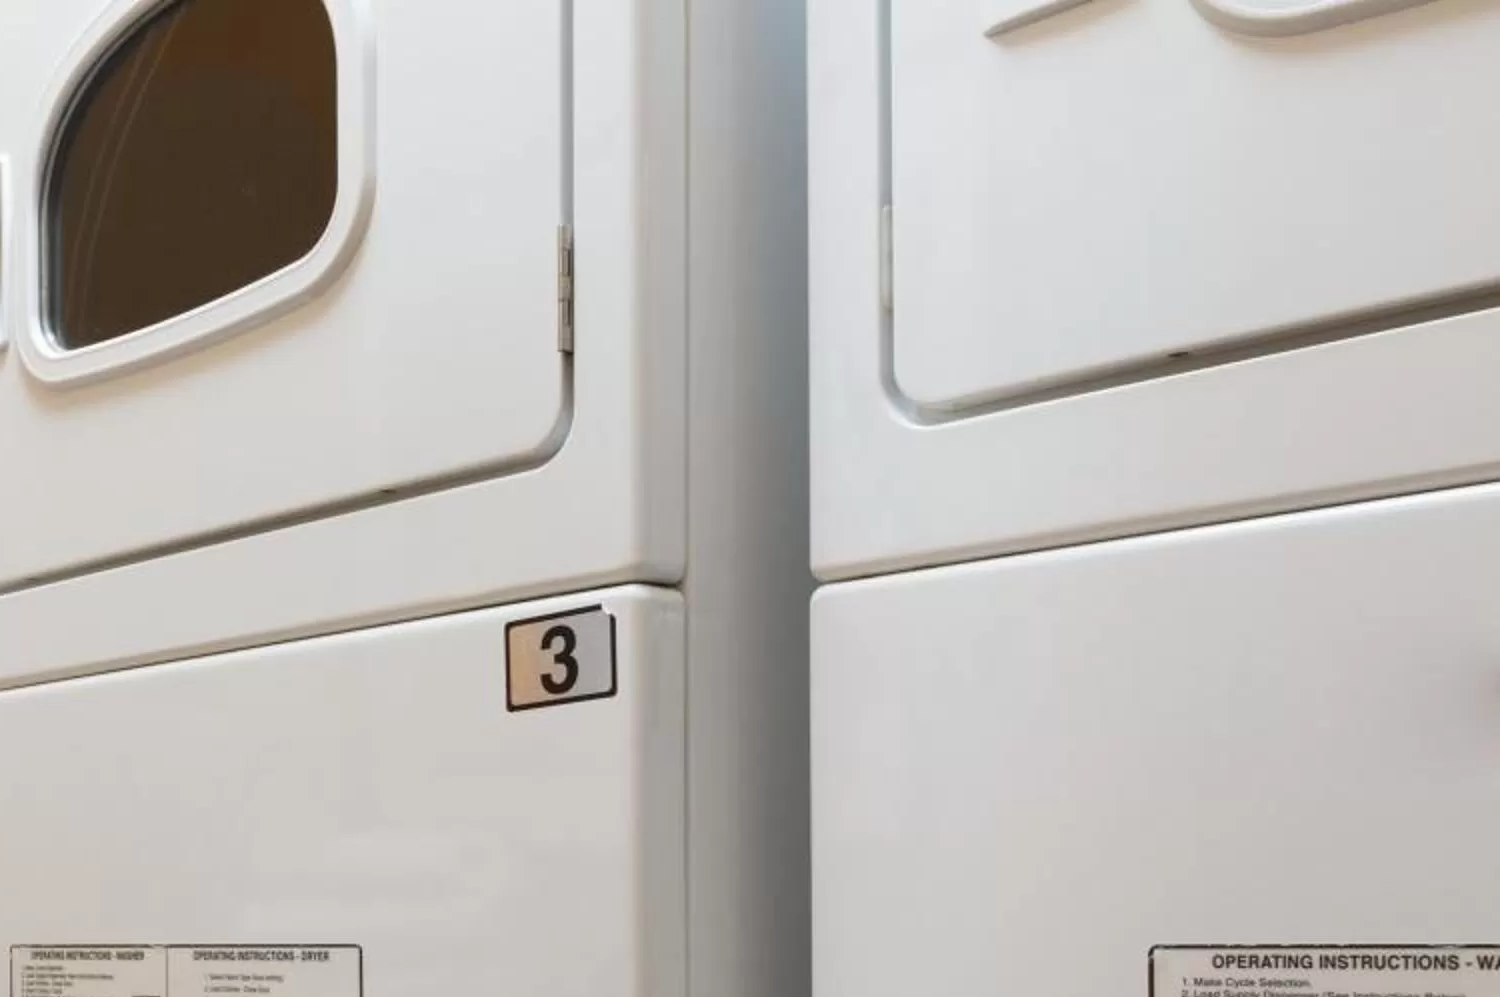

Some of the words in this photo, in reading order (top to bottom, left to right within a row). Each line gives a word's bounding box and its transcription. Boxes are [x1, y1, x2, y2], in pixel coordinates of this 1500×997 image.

[541, 625, 579, 694] 3
[1212, 954, 1313, 969] OPERATING
[1319, 954, 1460, 971] INSTRUCTIONS
[1193, 977, 1222, 987] Make
[1225, 977, 1256, 989] Cycle
